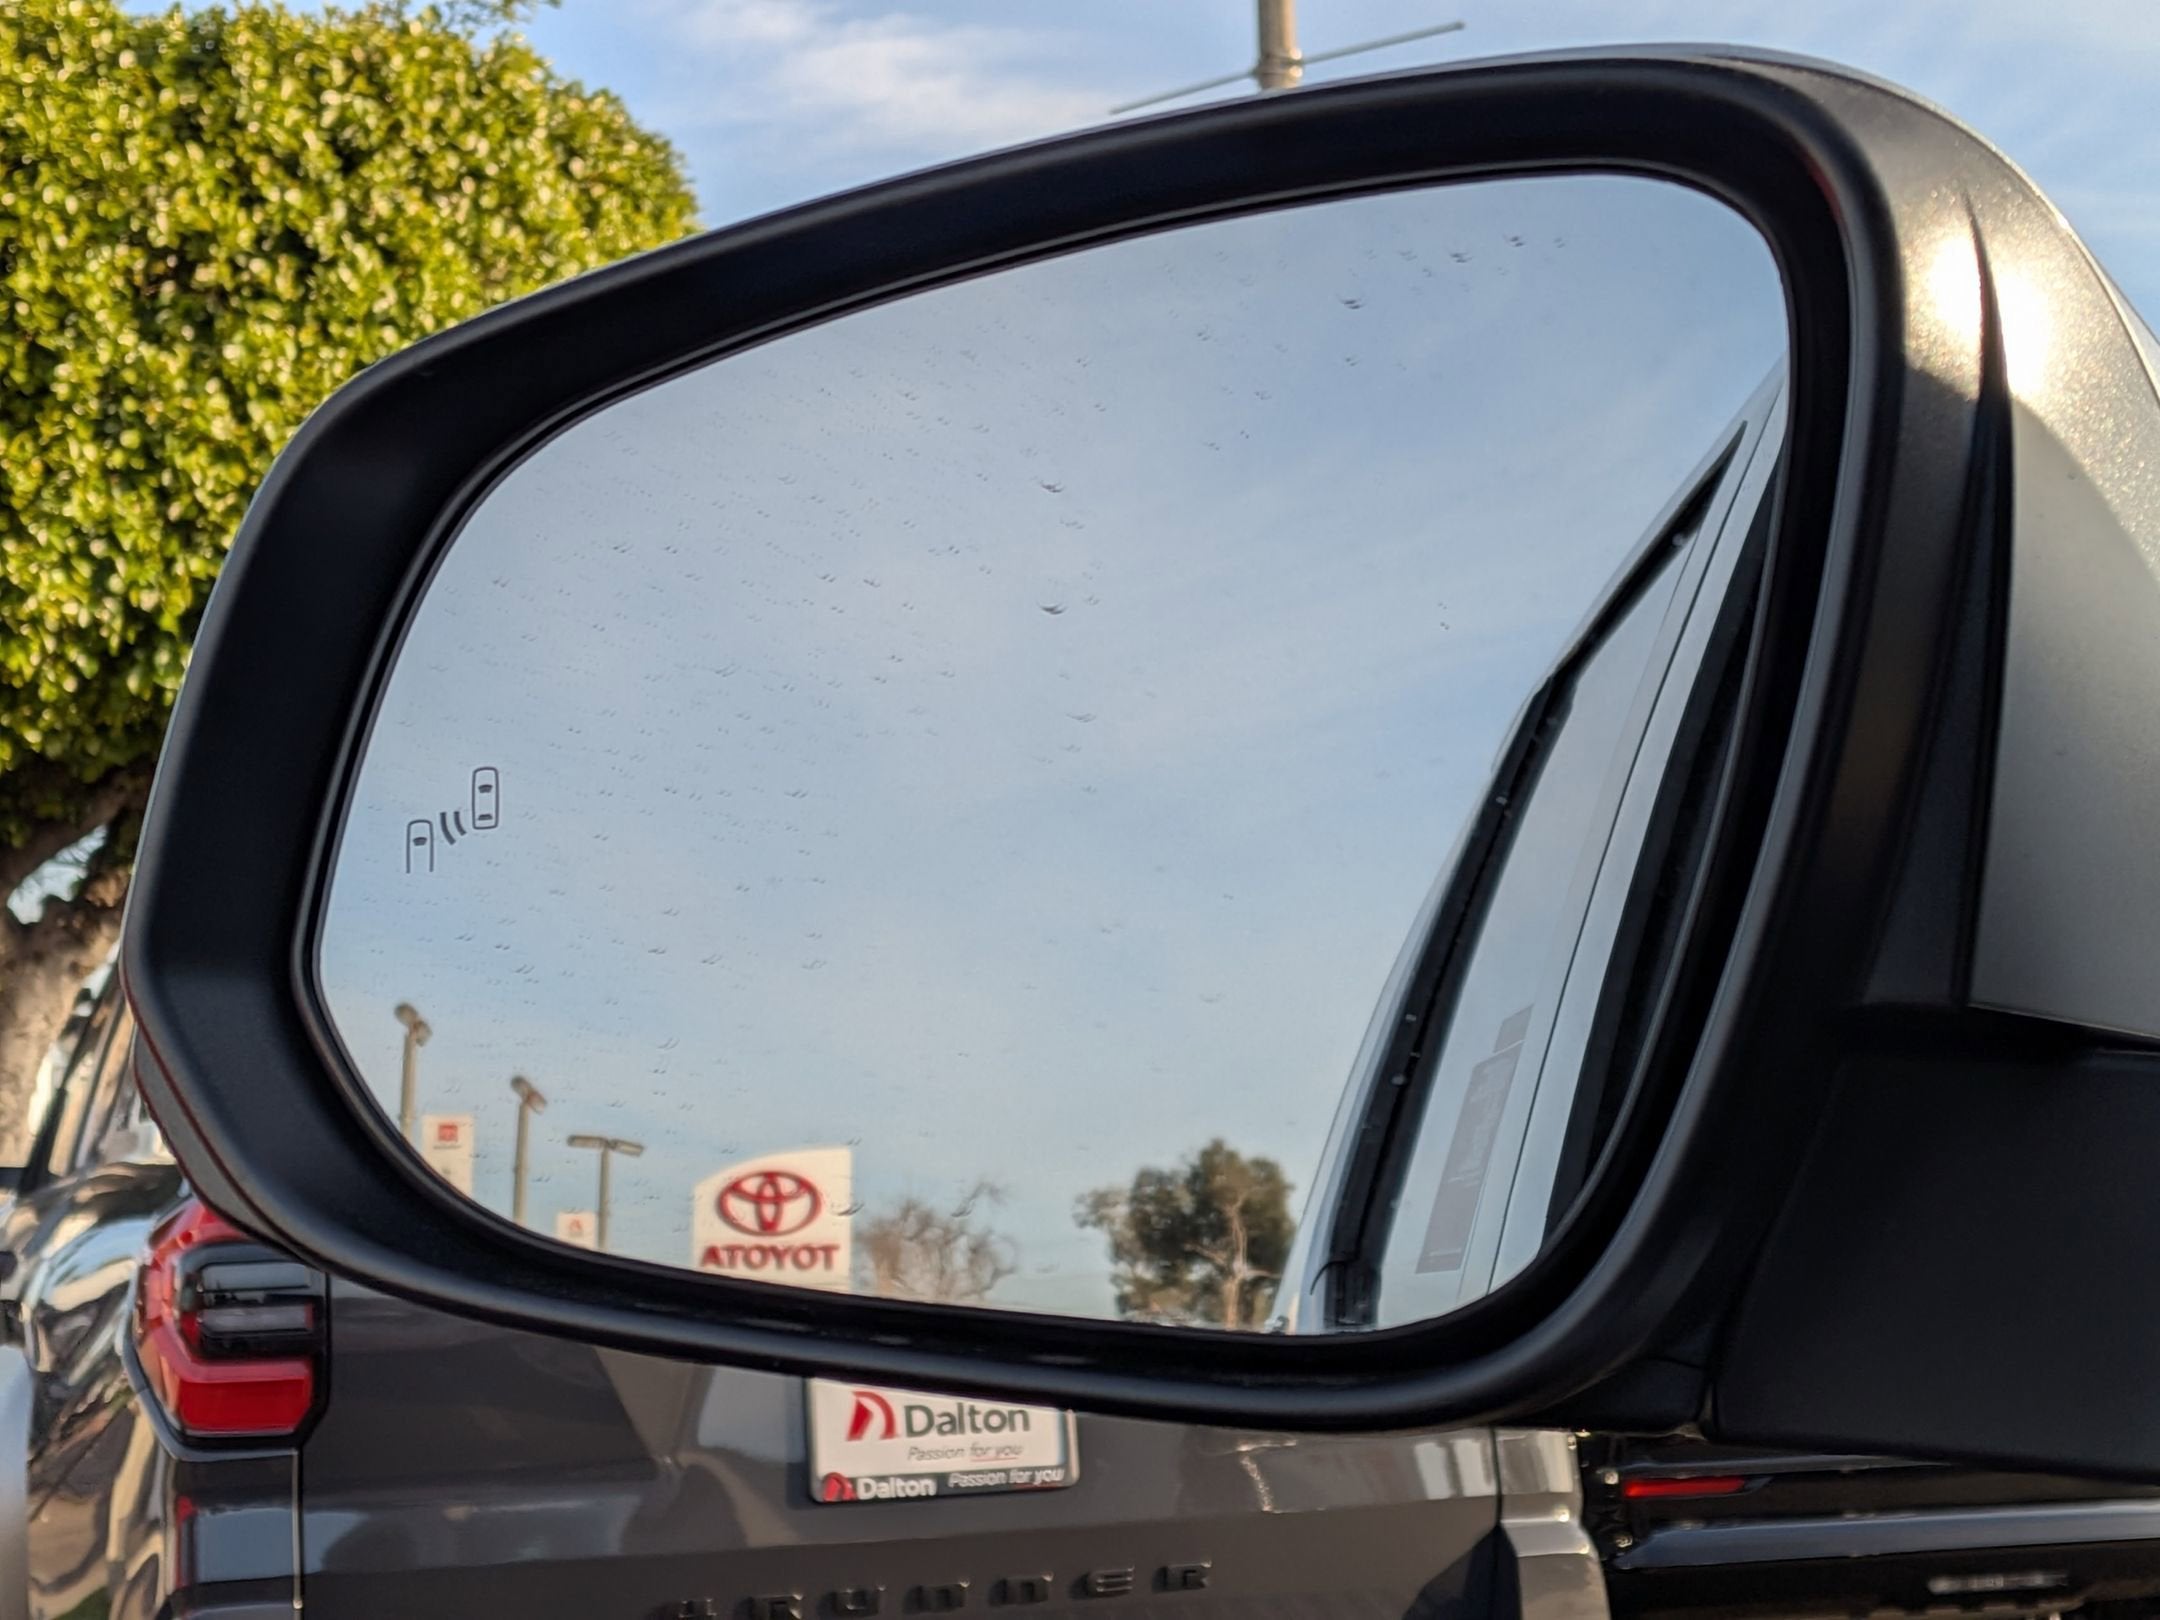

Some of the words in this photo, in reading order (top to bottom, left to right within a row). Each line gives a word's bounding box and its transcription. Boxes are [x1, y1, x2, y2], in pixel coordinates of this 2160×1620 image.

[904, 1402, 1030, 1438] Dalton
[907, 1446, 966, 1461] Passion
[970, 1442, 991, 1457] for
[994, 1443, 1024, 1458] you
[856, 1477, 937, 1500] Dalton
[948, 1470, 1007, 1488] Passion
[1009, 1468, 1031, 1485] for
[1032, 1468, 1065, 1485] you
